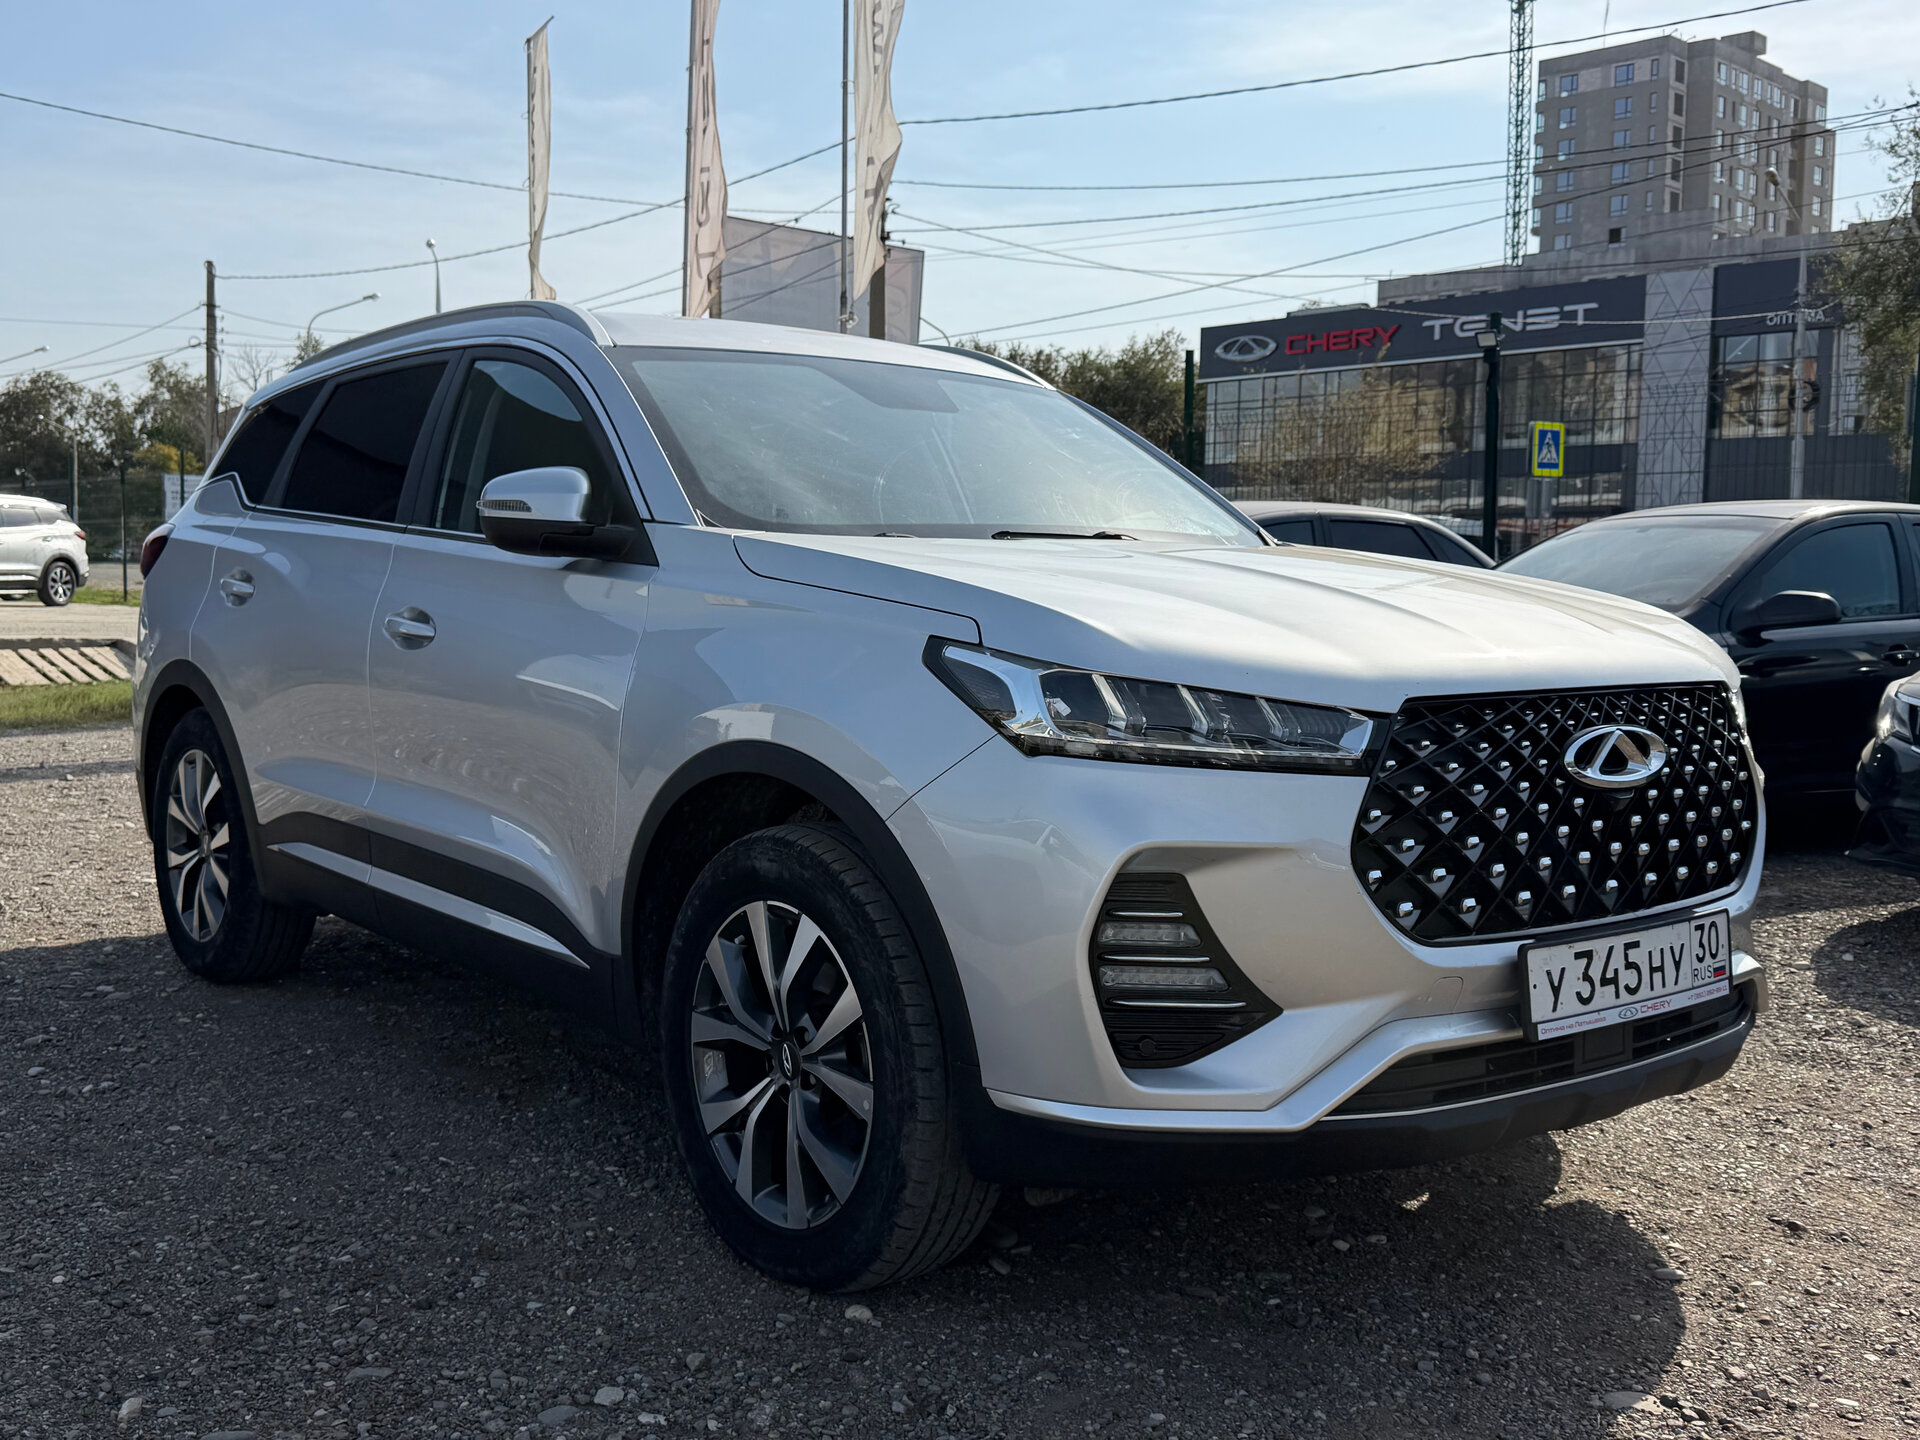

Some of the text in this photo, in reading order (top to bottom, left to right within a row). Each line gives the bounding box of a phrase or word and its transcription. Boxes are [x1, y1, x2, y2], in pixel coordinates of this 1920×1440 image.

[1285, 324, 1400, 355] CHERY
[1694, 920, 1720, 963] 30
[1693, 964, 1713, 983] RUS
[1640, 999, 1672, 1014] CHERY
